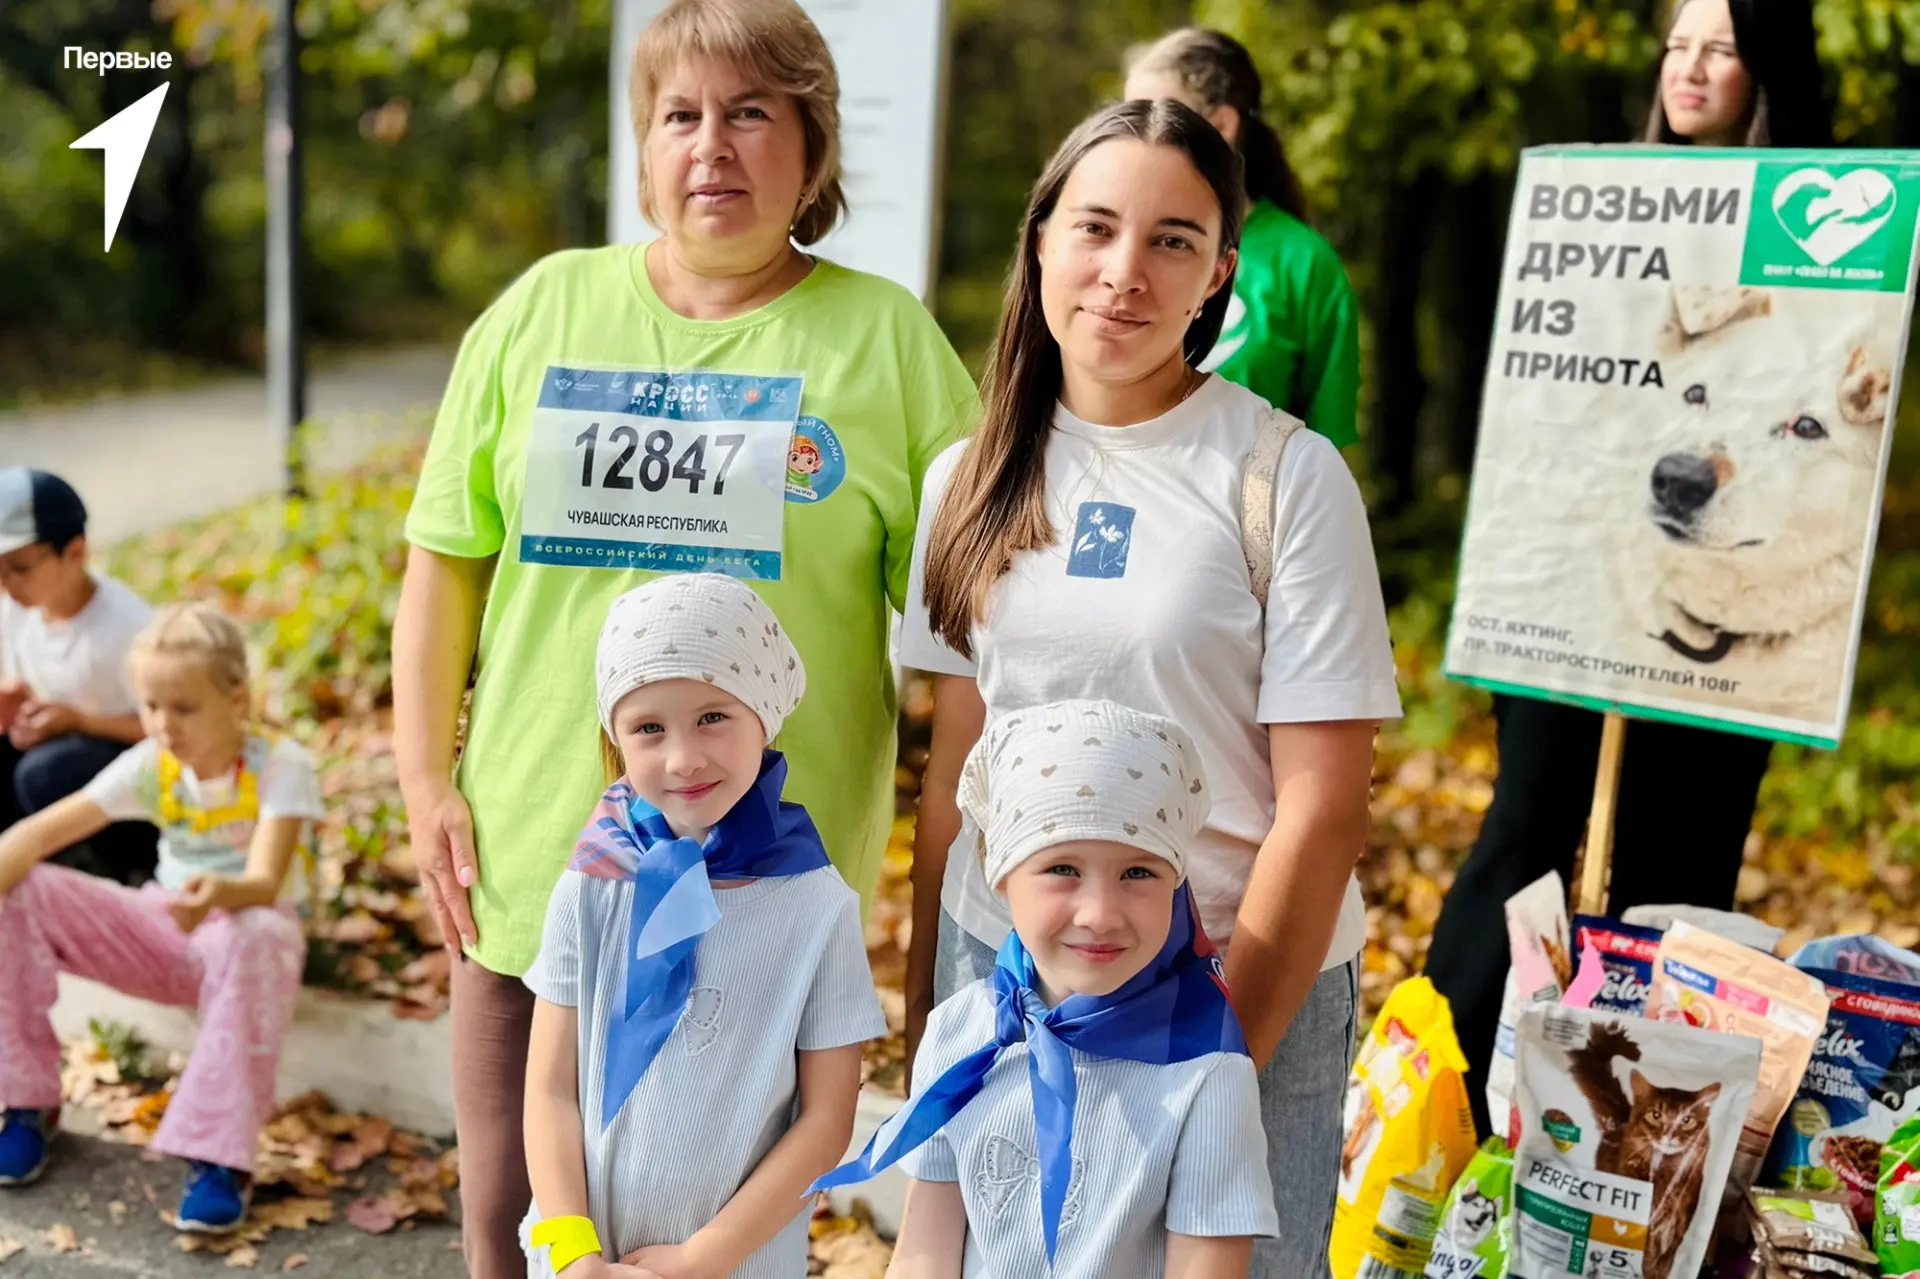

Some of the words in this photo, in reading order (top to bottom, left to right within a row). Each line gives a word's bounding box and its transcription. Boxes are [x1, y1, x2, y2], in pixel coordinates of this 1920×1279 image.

[1528, 184, 1740, 225] ВОЗЬМИ
[1517, 242, 1671, 282] ДРУГА
[1511, 299, 1577, 336] ИЗ
[1503, 350, 1665, 389] ПРИЮТА
[630, 397, 708, 412] НАЦИИ
[632, 381, 710, 403] КРОСС
[575, 422, 746, 495] 12847
[567, 510, 645, 529] ЧУВАШСКАЯ
[646, 515, 729, 534] РЕСПУБЛИКА
[535, 544, 668, 560] ВСЕРОССИЙСКИЙ
[1467, 615, 1503, 633] ОСТ.
[1506, 621, 1575, 645] ЯХТИНГ,
[1494, 640, 1695, 687] ТРАКТОРОСТРОИТЕЛЕЙ
[1699, 674, 1742, 694] 108Г
[1813, 1028, 1865, 1058] elix
[1528, 1161, 1607, 1202] PERFECT
[1611, 1187, 1641, 1211] FIT
[1609, 1249, 1629, 1268] 5
